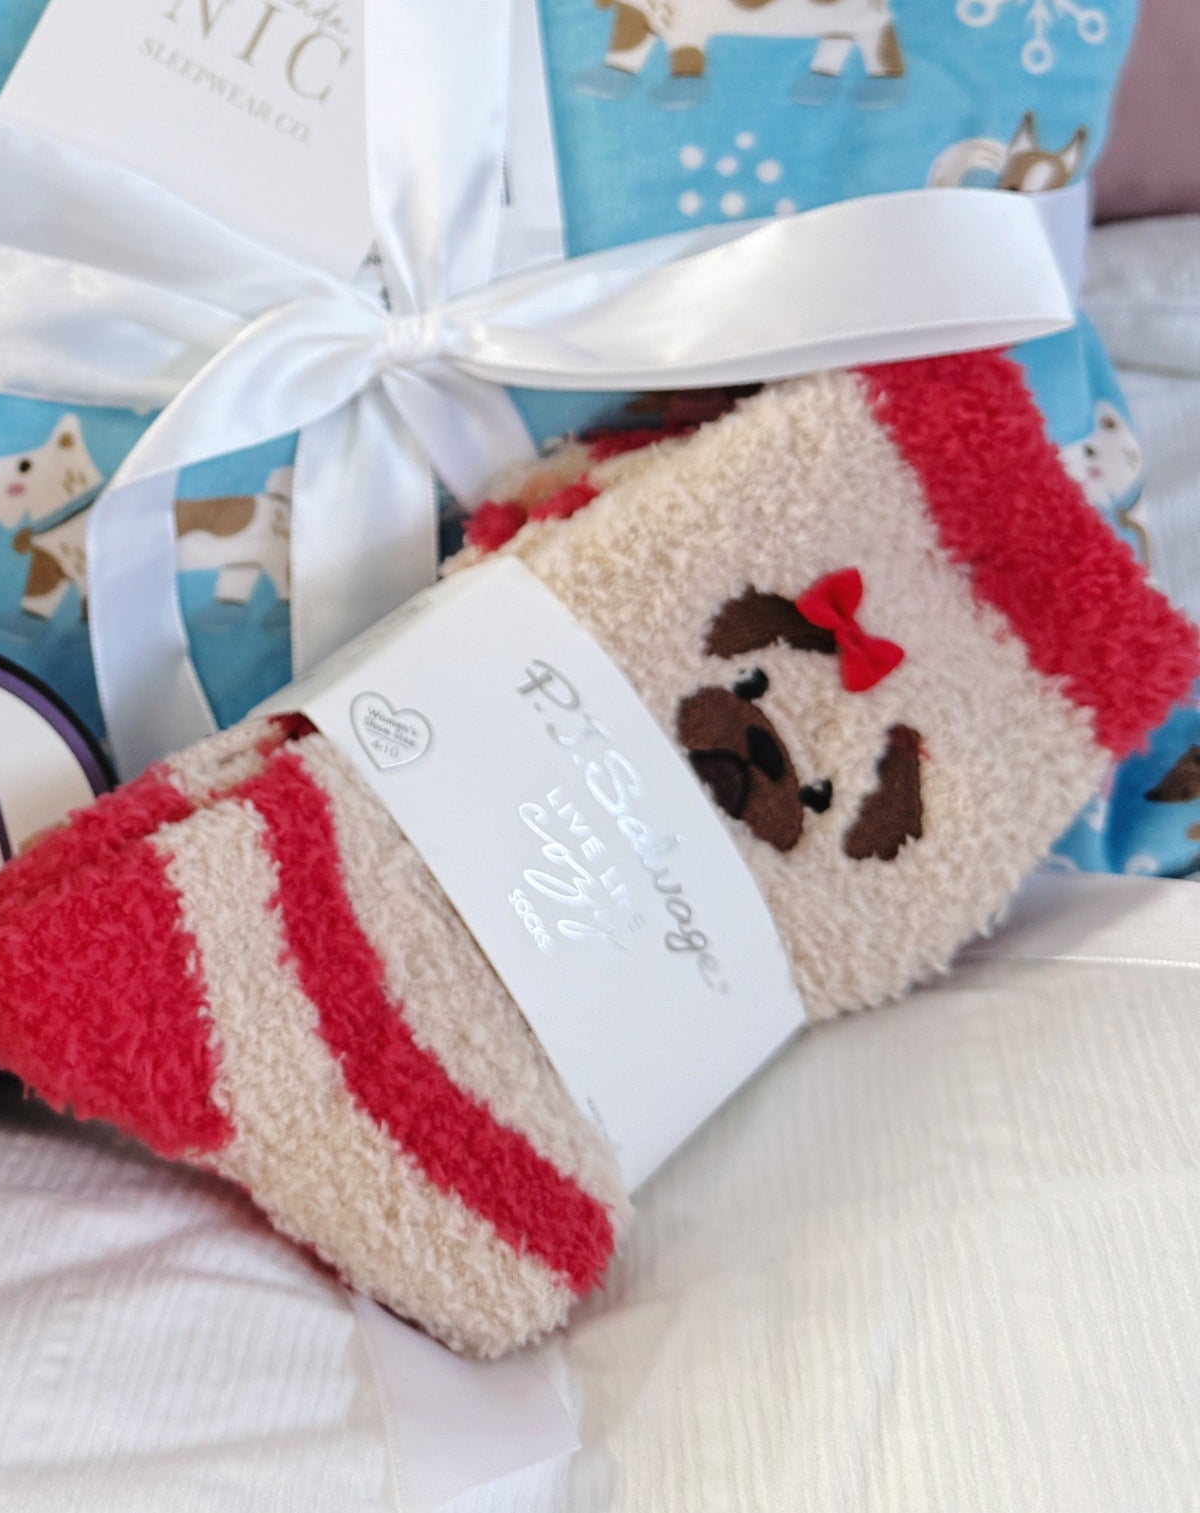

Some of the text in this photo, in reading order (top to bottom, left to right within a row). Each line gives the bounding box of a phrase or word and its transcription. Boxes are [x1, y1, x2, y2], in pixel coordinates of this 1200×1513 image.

[142, 38, 273, 125] SLEEPWEAR
[546, 785, 606, 863] LIVE
[508, 888, 552, 953] SOCKS
